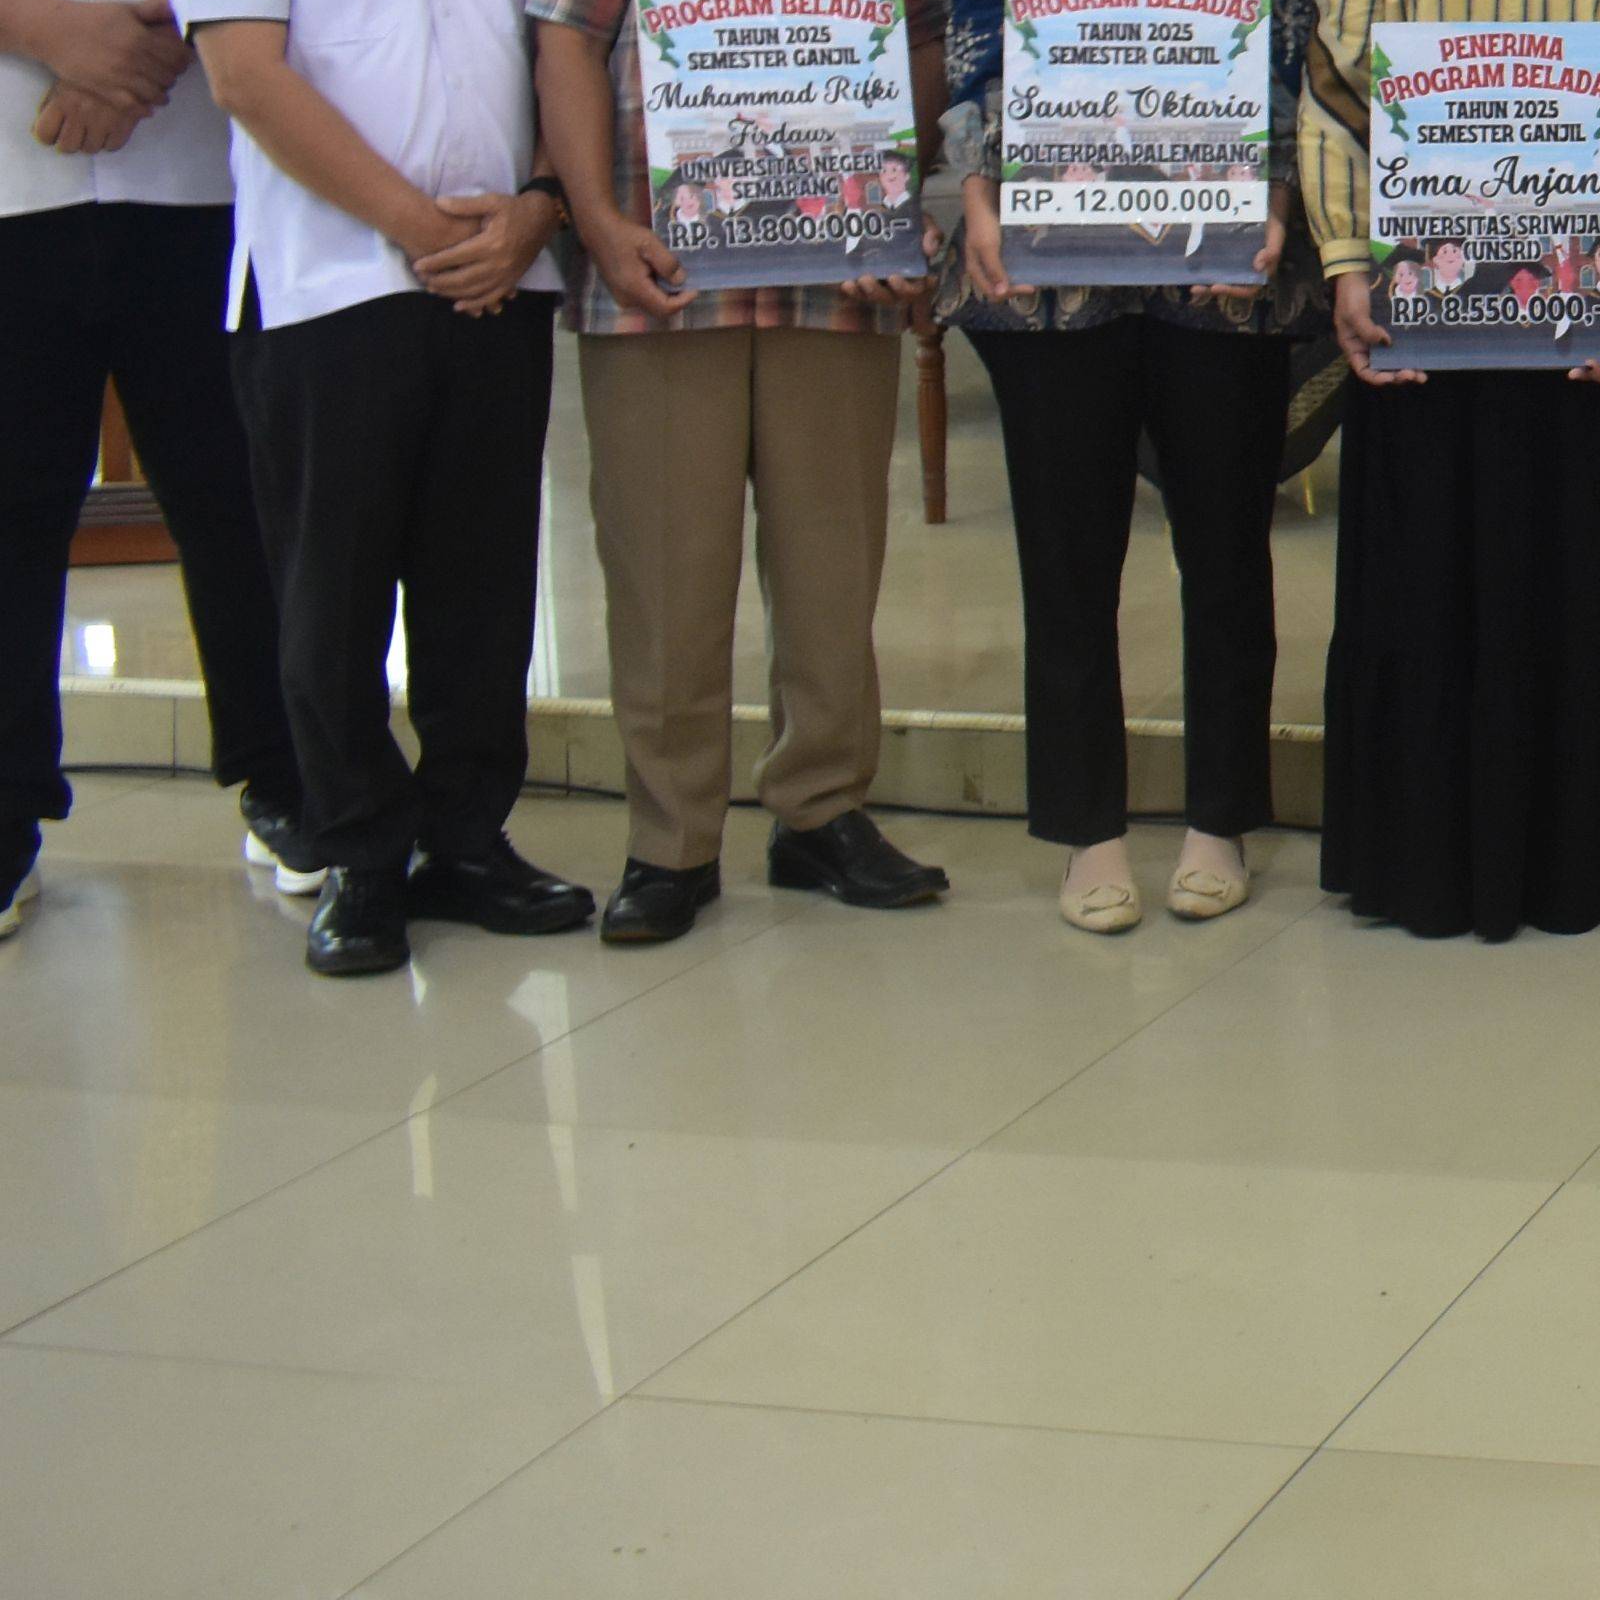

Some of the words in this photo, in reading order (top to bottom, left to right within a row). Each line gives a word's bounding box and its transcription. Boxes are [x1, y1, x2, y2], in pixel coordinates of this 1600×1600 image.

[714, 28, 780, 47] TAHUN
[786, 26, 831, 44] 2025
[1077, 23, 1141, 41] TAHUN
[1148, 23, 1193, 41] 2025
[688, 49, 788, 71] SEMESTER
[793, 47, 860, 67] GANJIL
[1048, 46, 1148, 65] SEMESTER
[1154, 47, 1220, 65] GANJIL
[1438, 33, 1564, 62] PENERIMA
[1378, 63, 1505, 104] PROGRAM
[647, 81, 817, 112] Muhammad
[1127, 85, 1262, 119] Oktaria
[1445, 102, 1508, 119] TAHUN
[1513, 101, 1558, 118] 2025
[728, 118, 836, 149] Firdaus
[1417, 124, 1514, 144] SEMESTER
[1520, 123, 1586, 142] GANJIL
[682, 158, 809, 179] UNIVERSITAS
[812, 153, 883, 174] NEGERI
[1007, 144, 1123, 164] POLTEKPAR
[1130, 143, 1259, 163] PALEMBANG
[732, 179, 839, 199] SEMARANG
[1377, 156, 1471, 199] Ema
[1011, 190, 1061, 212] RP.
[1075, 189, 1251, 215] 12.000.000,-
[671, 222, 718, 249] RP.
[1378, 216, 1511, 237] UNIVERSITAS
[1463, 241, 1541, 262] (UNSRI)
[1392, 298, 1437, 325] RP.
